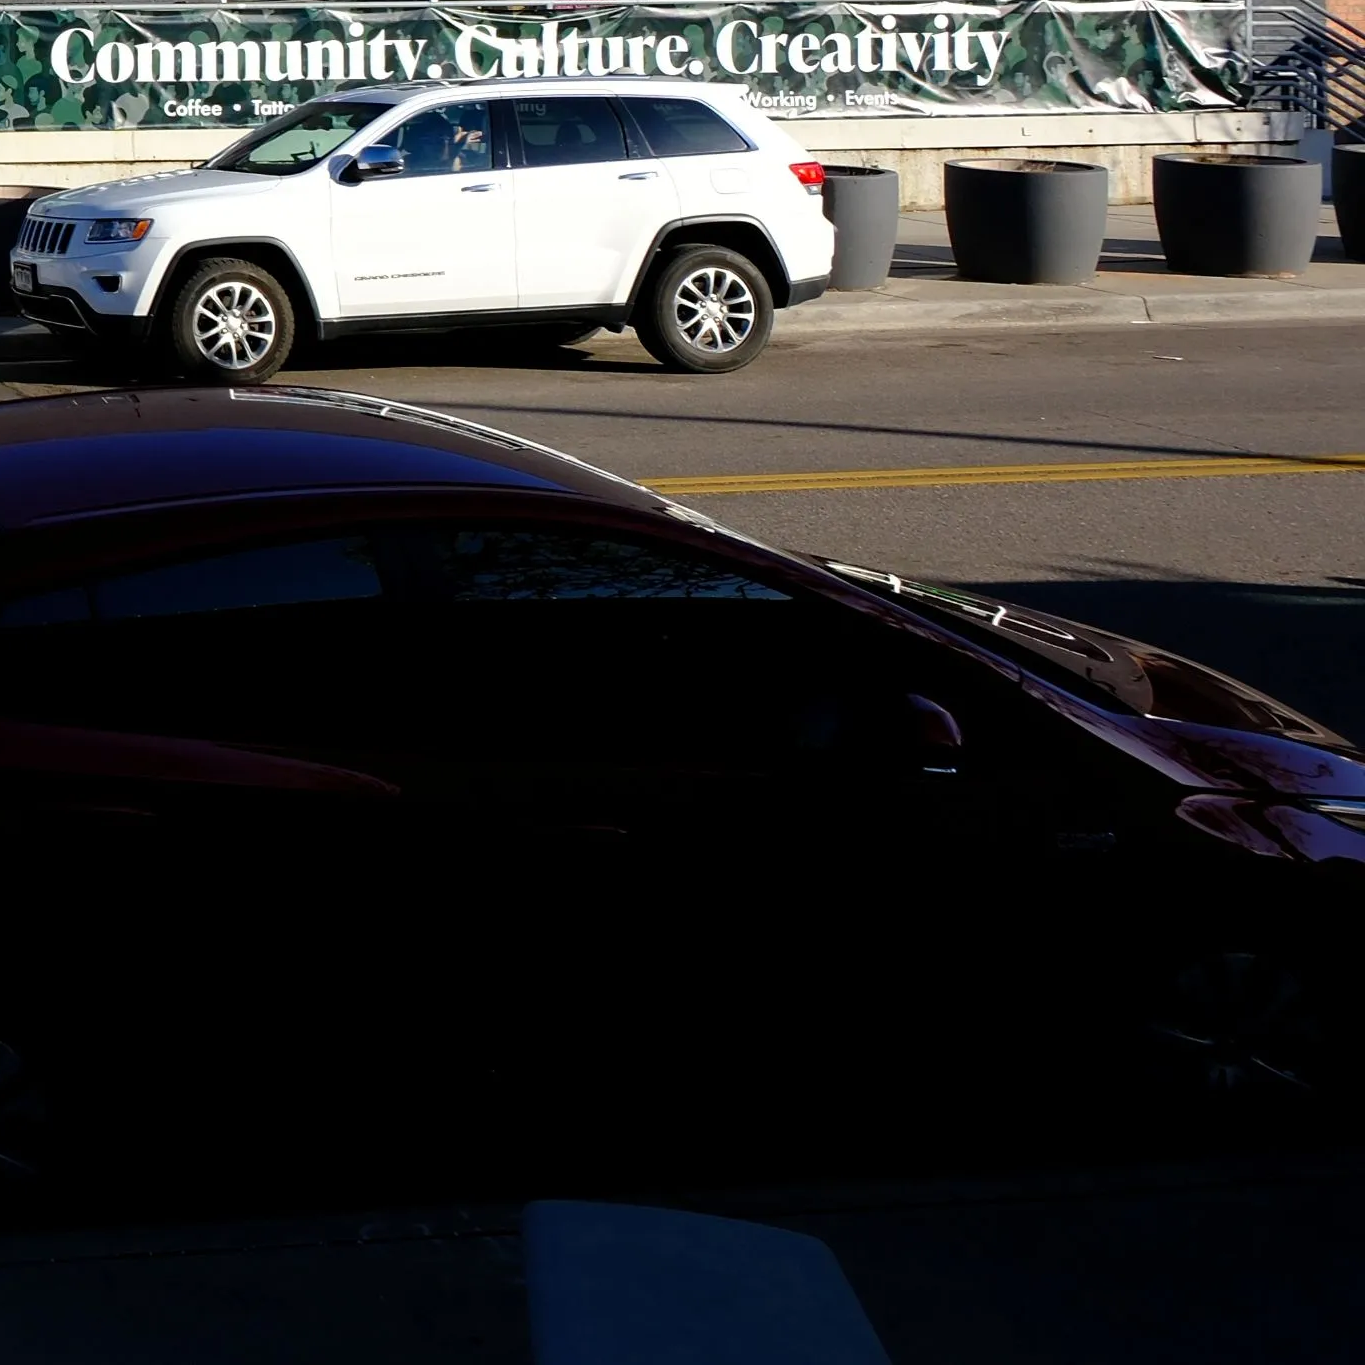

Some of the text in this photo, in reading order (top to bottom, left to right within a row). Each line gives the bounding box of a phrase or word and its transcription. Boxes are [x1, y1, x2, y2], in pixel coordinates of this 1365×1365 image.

[50, 14, 1011, 87] Community. Culture. Creativity
[163, 99, 223, 117] Coffee
[744, 90, 899, 112] Working Events
